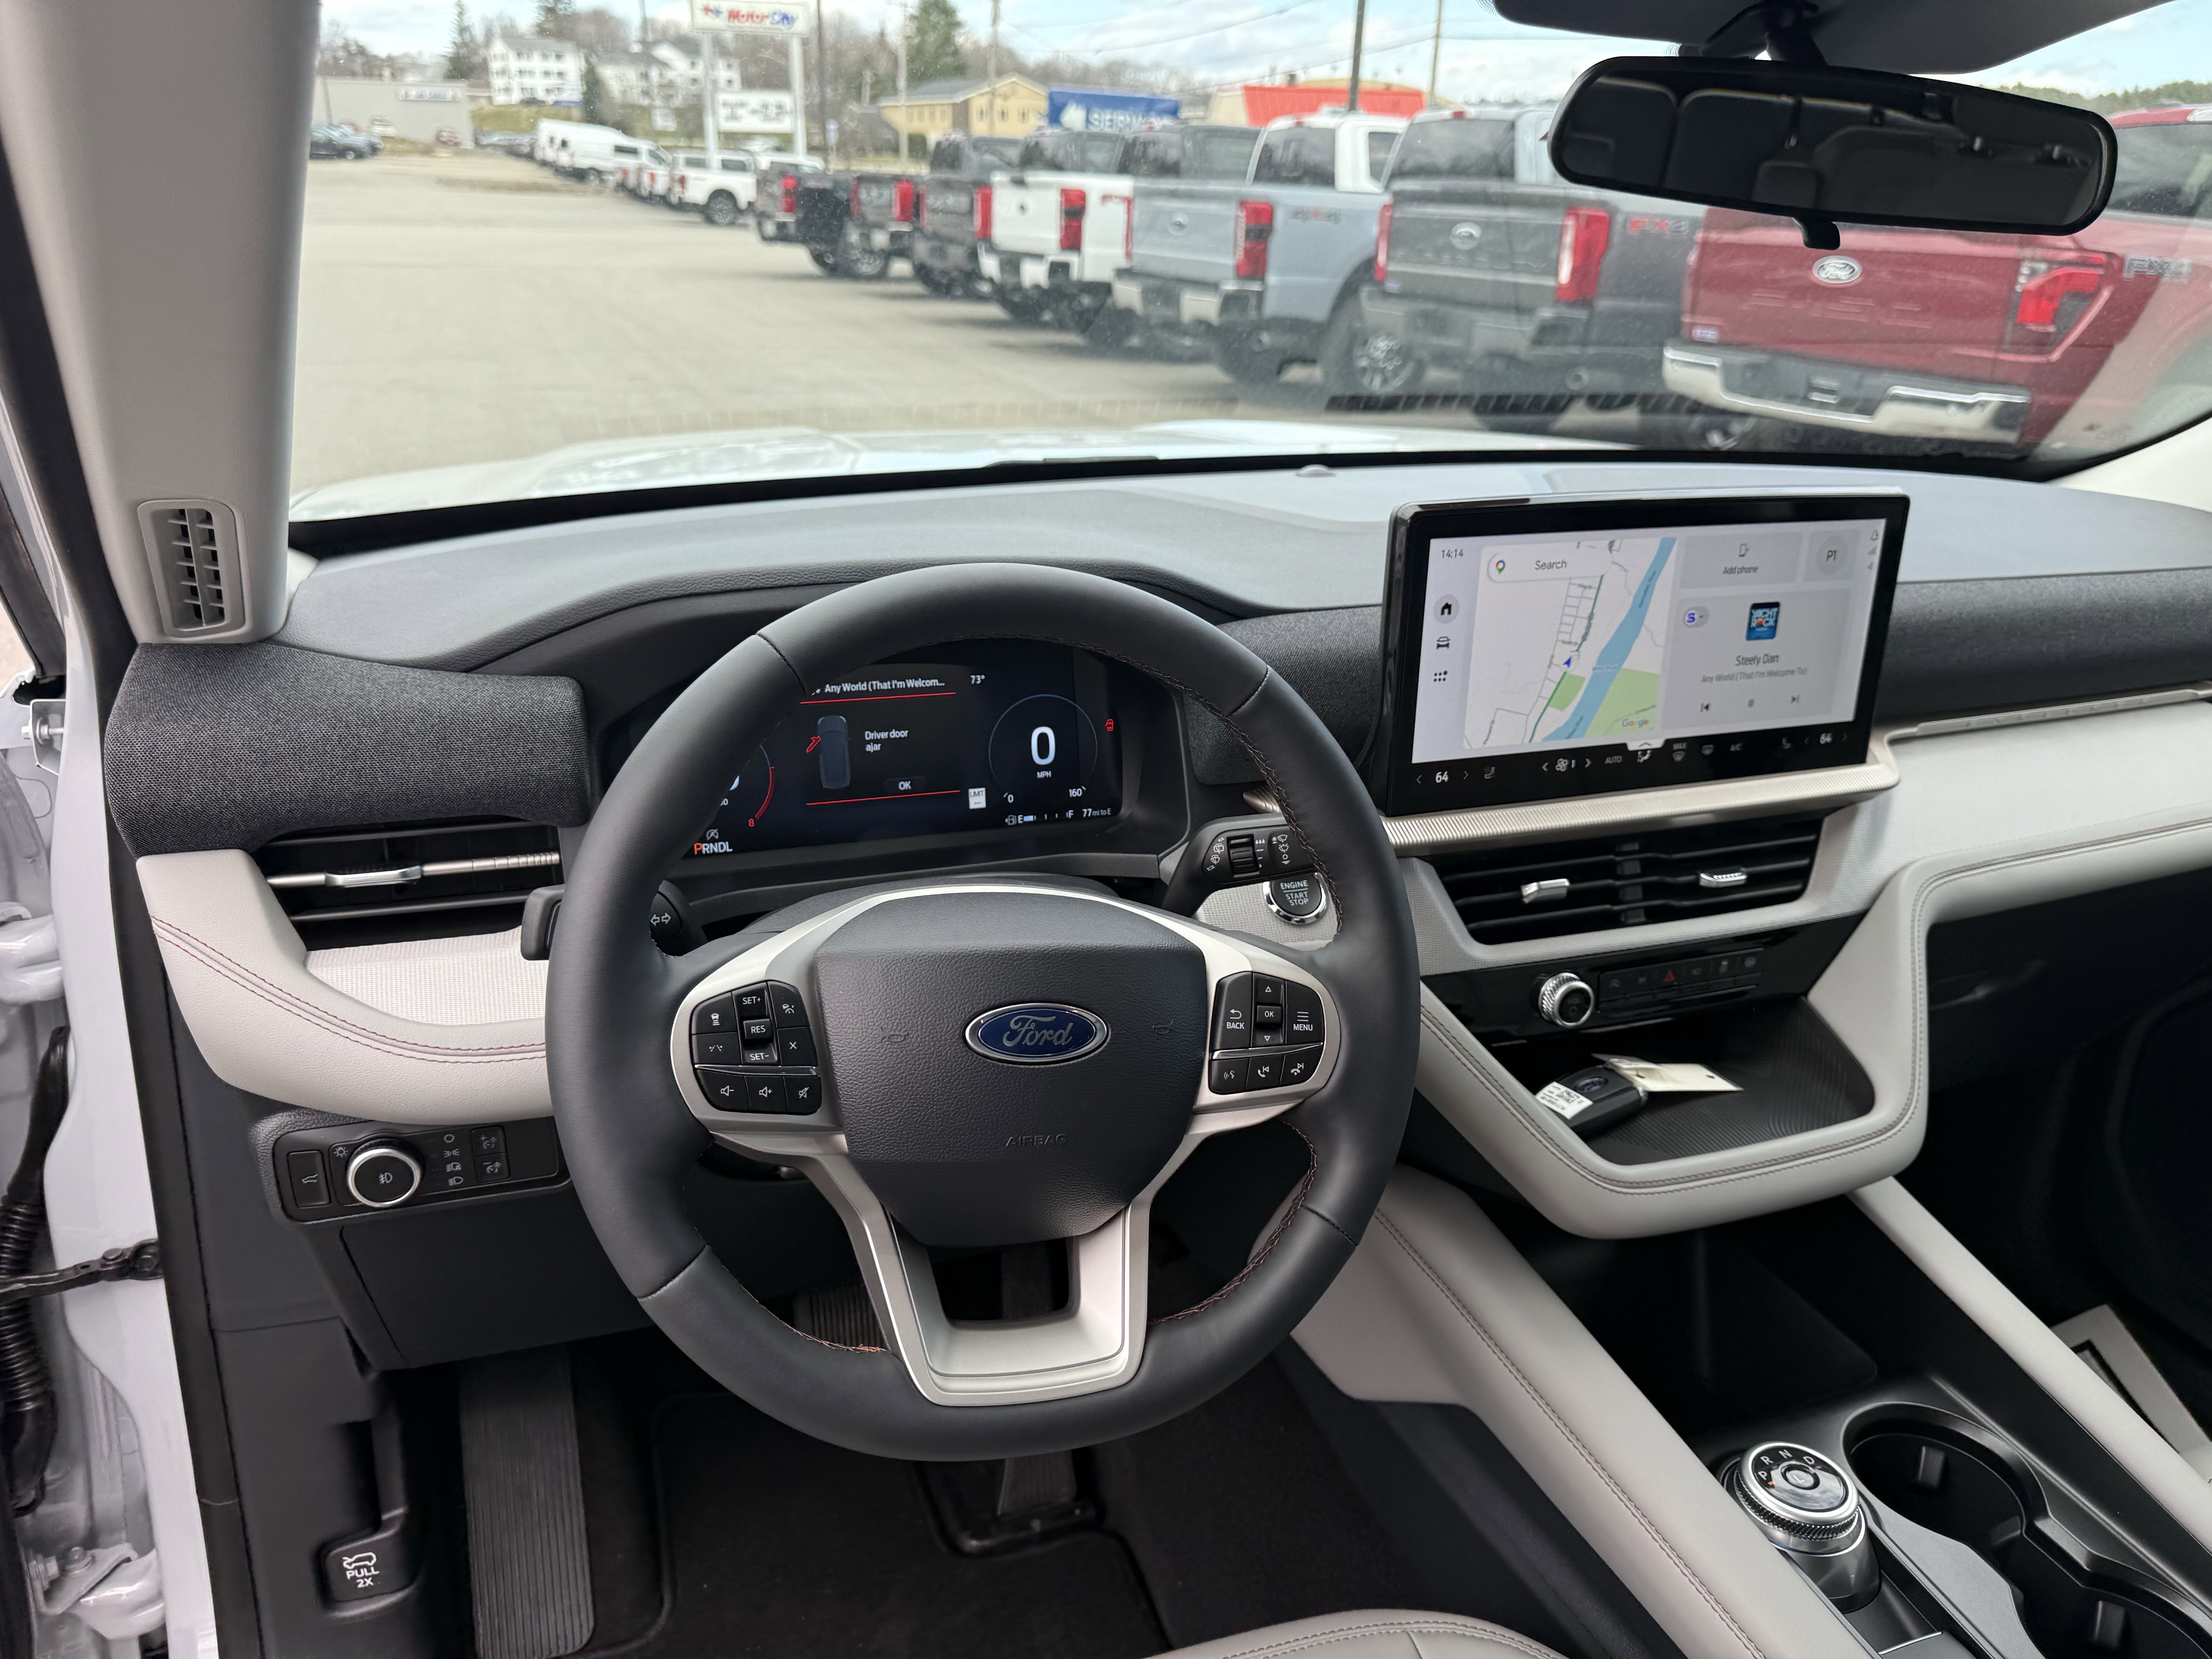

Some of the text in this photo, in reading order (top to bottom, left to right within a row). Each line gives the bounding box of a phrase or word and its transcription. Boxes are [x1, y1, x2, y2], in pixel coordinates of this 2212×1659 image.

[1441, 549, 1463, 558] 14:14
[1534, 559, 1567, 571] Search
[1723, 566, 1758, 575] Add phone
[1735, 653, 1779, 666] Steely Dan
[970, 675, 986, 685] 73°
[824, 678, 945, 694] Any World (That I'm Welcom...
[1622, 718, 1649, 728] Google
[864, 728, 909, 740] Driver door
[865, 742, 882, 752] ajar
[1030, 726, 1056, 766] 0
[1673, 742, 1687, 750] MAX
[1730, 743, 1742, 752] A/C
[1605, 755, 1623, 764] AUTO
[1037, 771, 1052, 779] MPH
[1436, 771, 1449, 783] 64
[898, 781, 912, 791] OK
[1068, 788, 1082, 798] 160
[1007, 794, 1014, 804] 0
[1068, 810, 1074, 819] F
[1082, 808, 1092, 817] 77
[748, 818, 755, 827] 8
[1017, 814, 1024, 824] E
[693, 841, 733, 855] PRNDL
[1280, 880, 1308, 890] ENGINE
[1285, 891, 1308, 900] START
[1289, 898, 1309, 906] STOP
[742, 996, 761, 1005] SET+
[750, 1025, 766, 1034] RES
[1002, 1015, 1074, 1047] Ford
[1226, 1022, 1245, 1030] BACK
[749, 1052, 769, 1061] SET-
[1005, 1133, 1067, 1147] AIRBAG
[1757, 1449, 1815, 1481] P R N D
[1792, 1474, 1805, 1484] L
[346, 1566, 380, 1580] PULL
[356, 1577, 374, 1589] 2X
